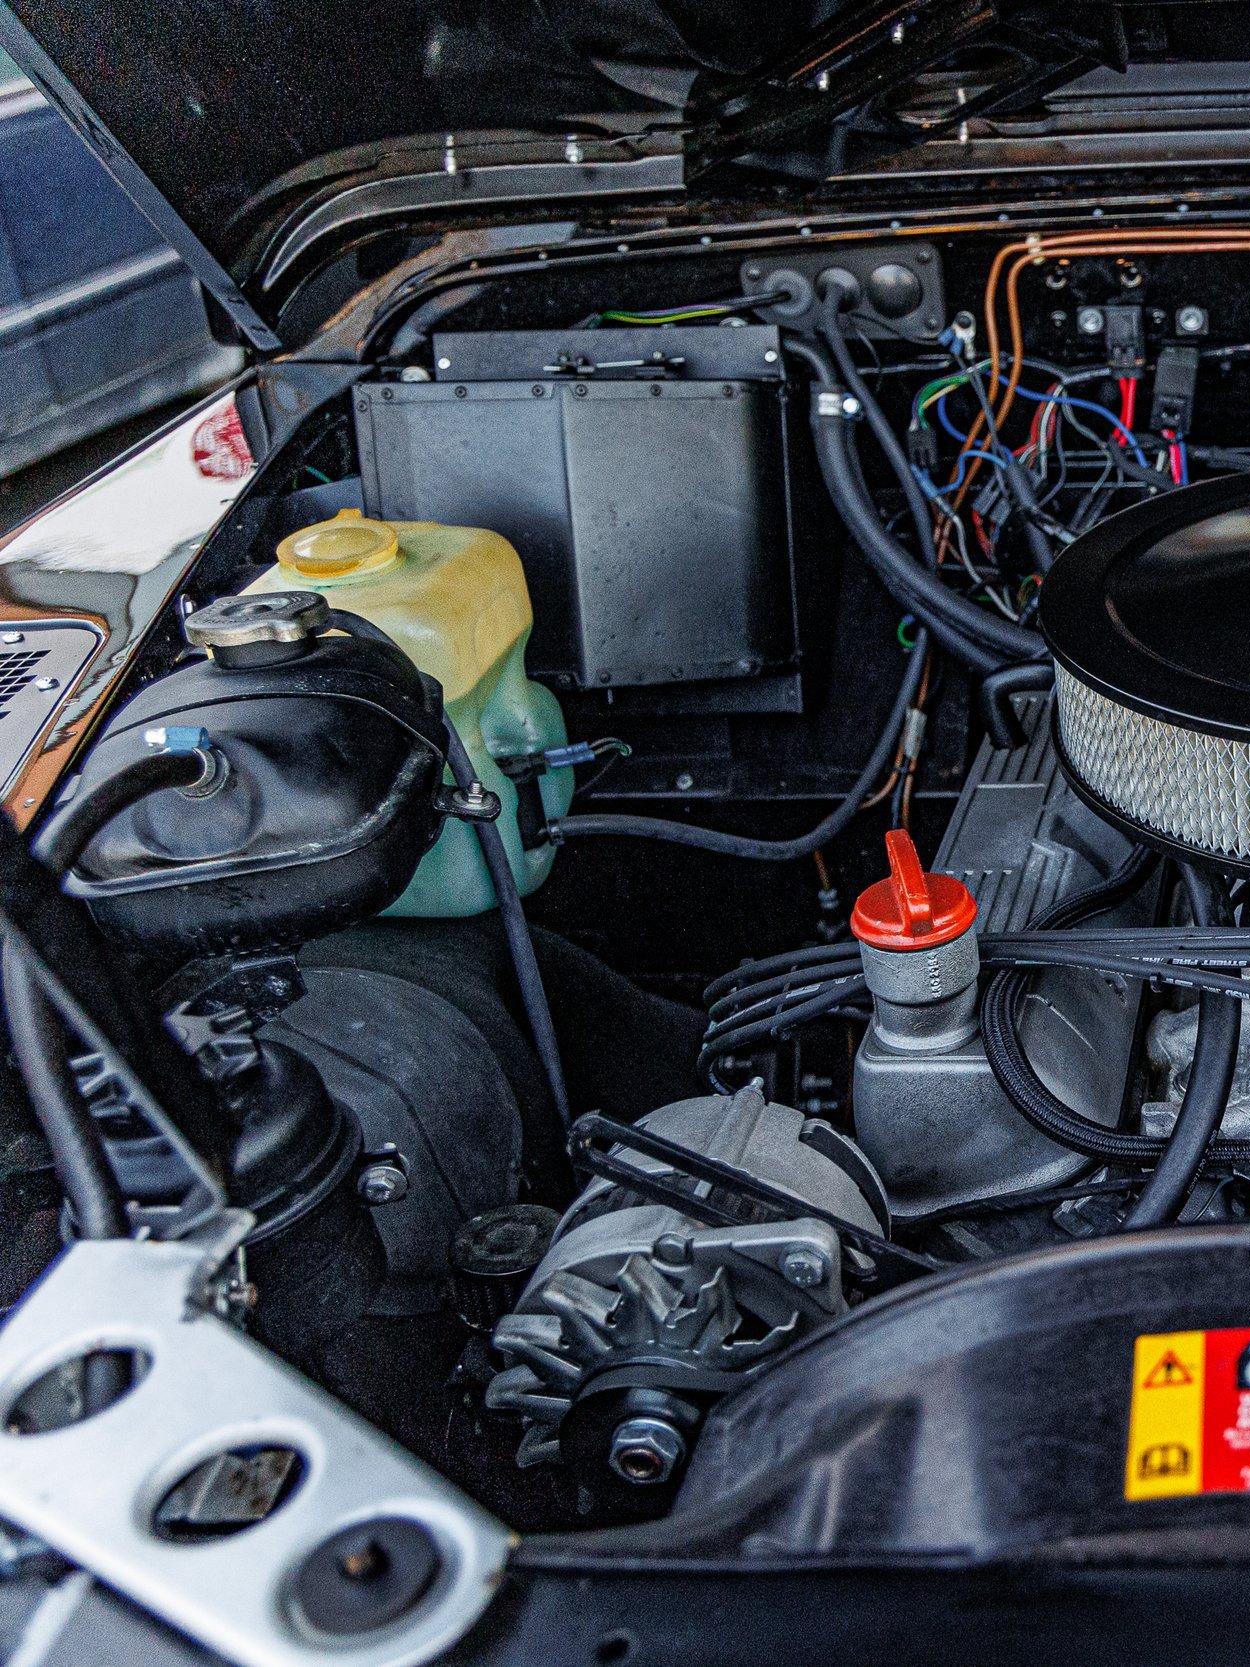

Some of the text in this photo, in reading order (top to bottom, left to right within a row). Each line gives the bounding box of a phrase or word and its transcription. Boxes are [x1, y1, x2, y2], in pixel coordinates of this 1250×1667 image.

[1171, 958, 1199, 966] FIRE
[1201, 959, 1248, 967] STREET
[1224, 989, 1250, 1000] MSD
